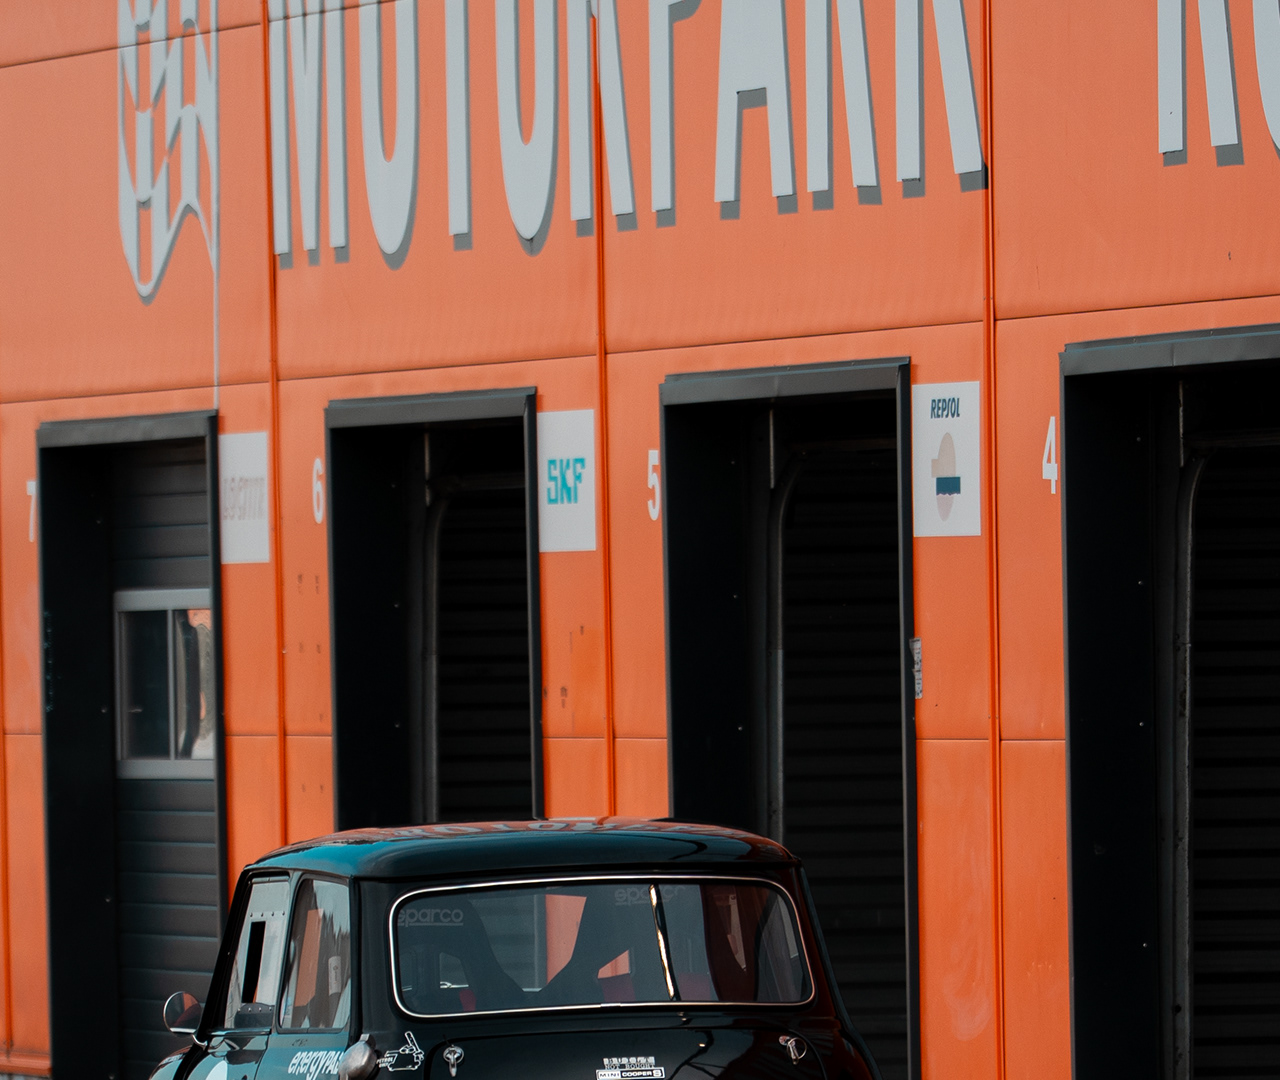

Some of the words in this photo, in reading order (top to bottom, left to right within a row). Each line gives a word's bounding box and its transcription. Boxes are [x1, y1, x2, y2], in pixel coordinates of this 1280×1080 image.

[930, 397, 961, 419] REPSOL
[547, 458, 586, 505] SKF
[648, 449, 660, 521] 5
[1042, 415, 1058, 495] 4
[26, 480, 37, 542] 7
[312, 458, 324, 524] 6
